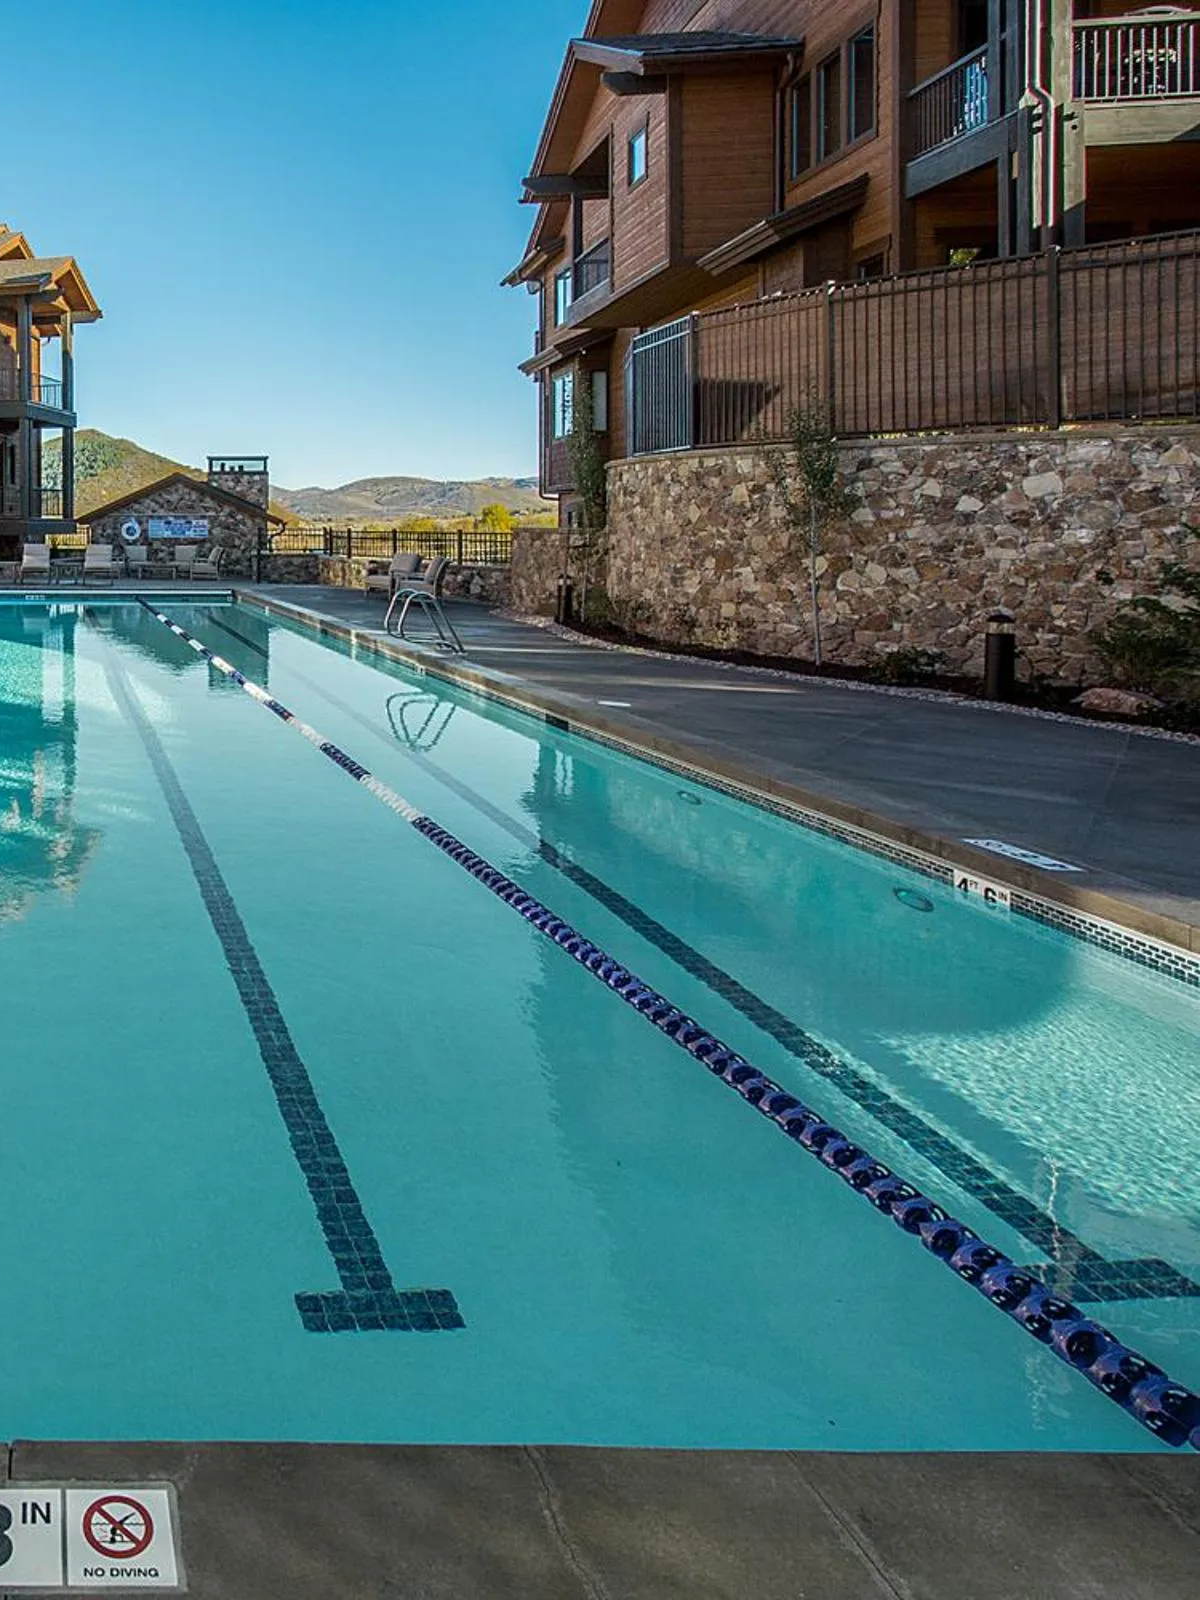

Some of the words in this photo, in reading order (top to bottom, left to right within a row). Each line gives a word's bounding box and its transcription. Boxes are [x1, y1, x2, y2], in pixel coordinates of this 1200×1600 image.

[21, 1502, 51, 1525] IN
[83, 1567, 106, 1578] NO
[109, 1567, 160, 1578] DIVING
